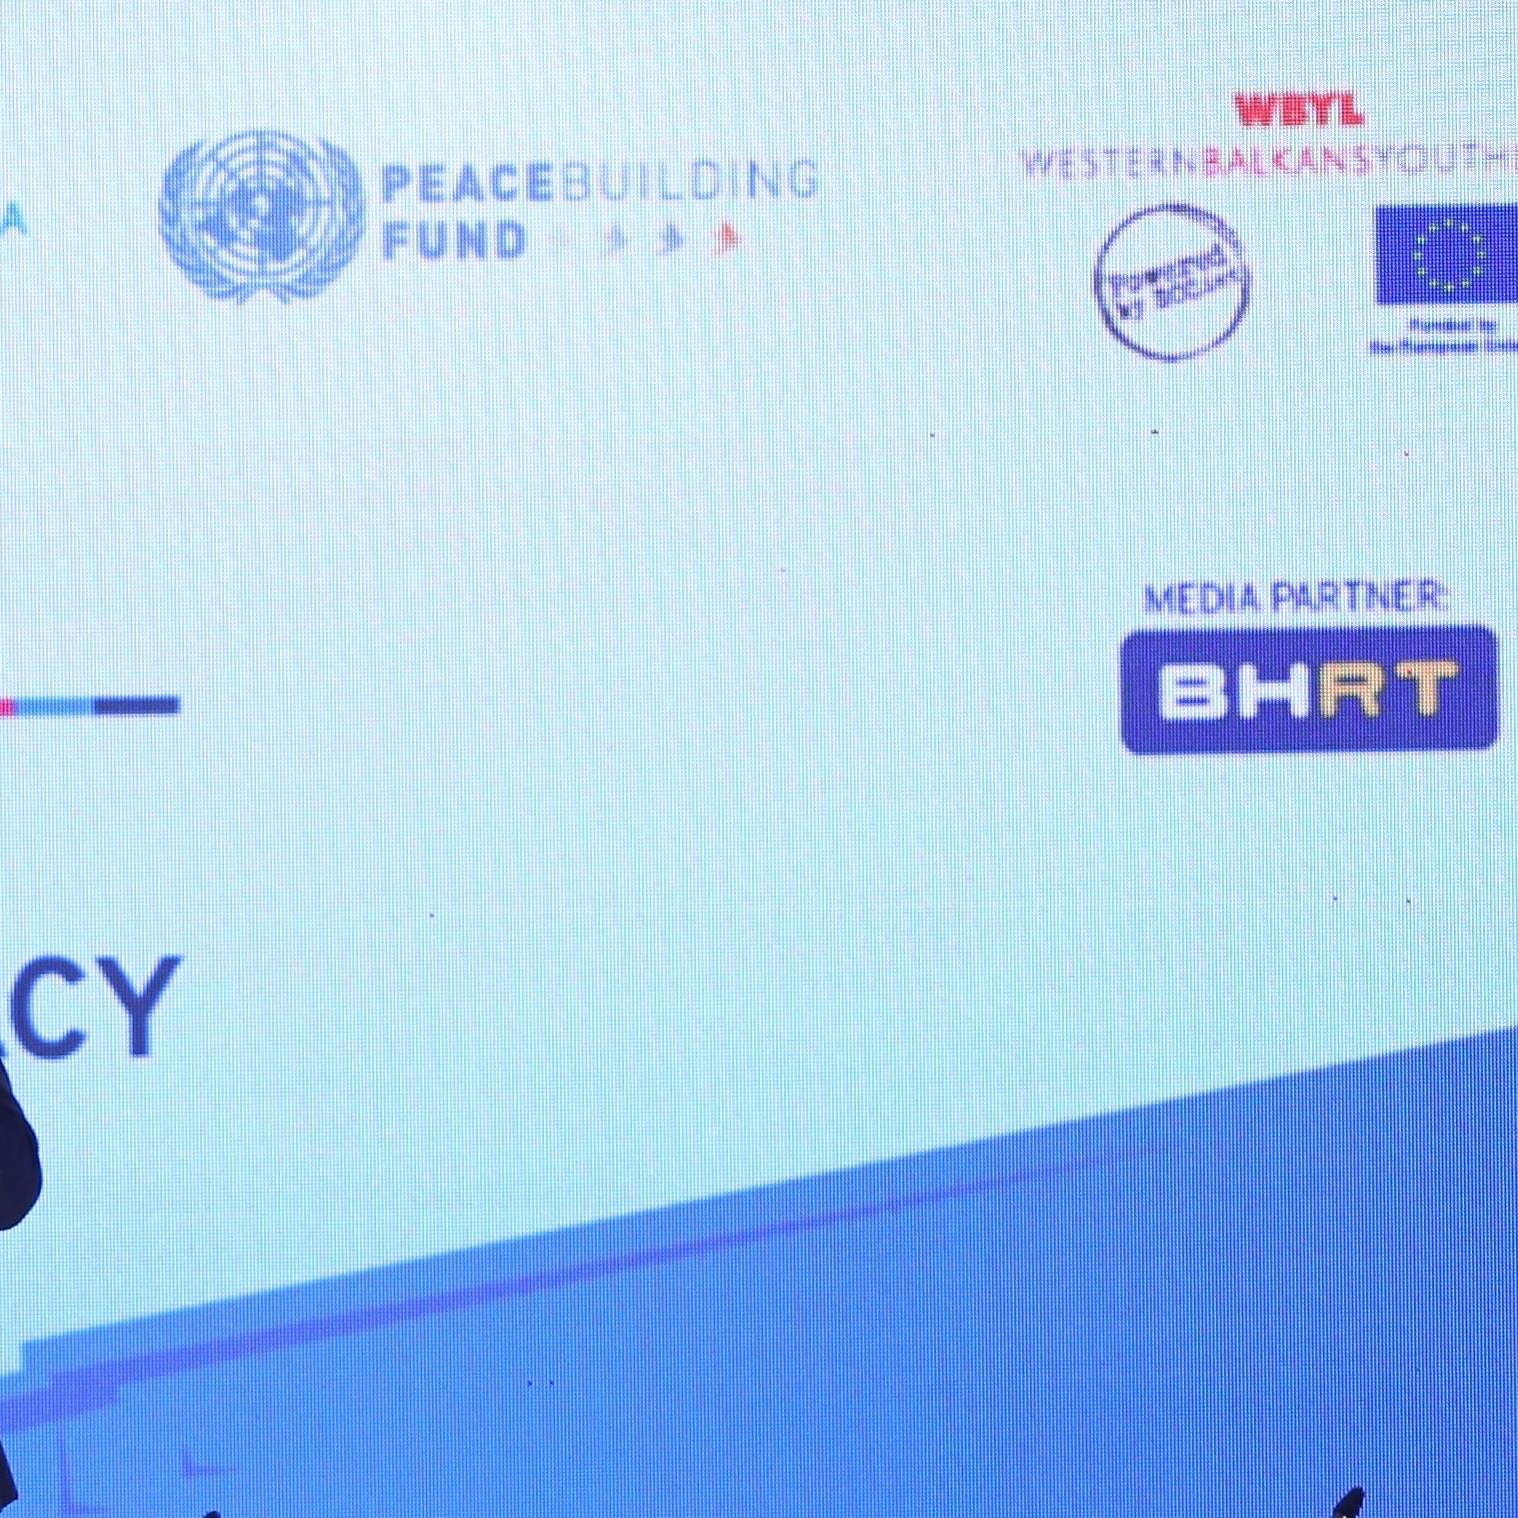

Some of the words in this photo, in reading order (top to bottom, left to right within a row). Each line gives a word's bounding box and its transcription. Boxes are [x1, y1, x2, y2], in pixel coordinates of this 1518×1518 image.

[379, 158, 819, 205] PEACEBUILDING
[1017, 142, 1518, 182] WESTERNBALKANSYOUTH
[381, 218, 528, 261] FUND
[1142, 580, 1261, 617] MEDIA
[1269, 576, 1451, 614] PARTNER:
[1157, 658, 1462, 722] BHRT
